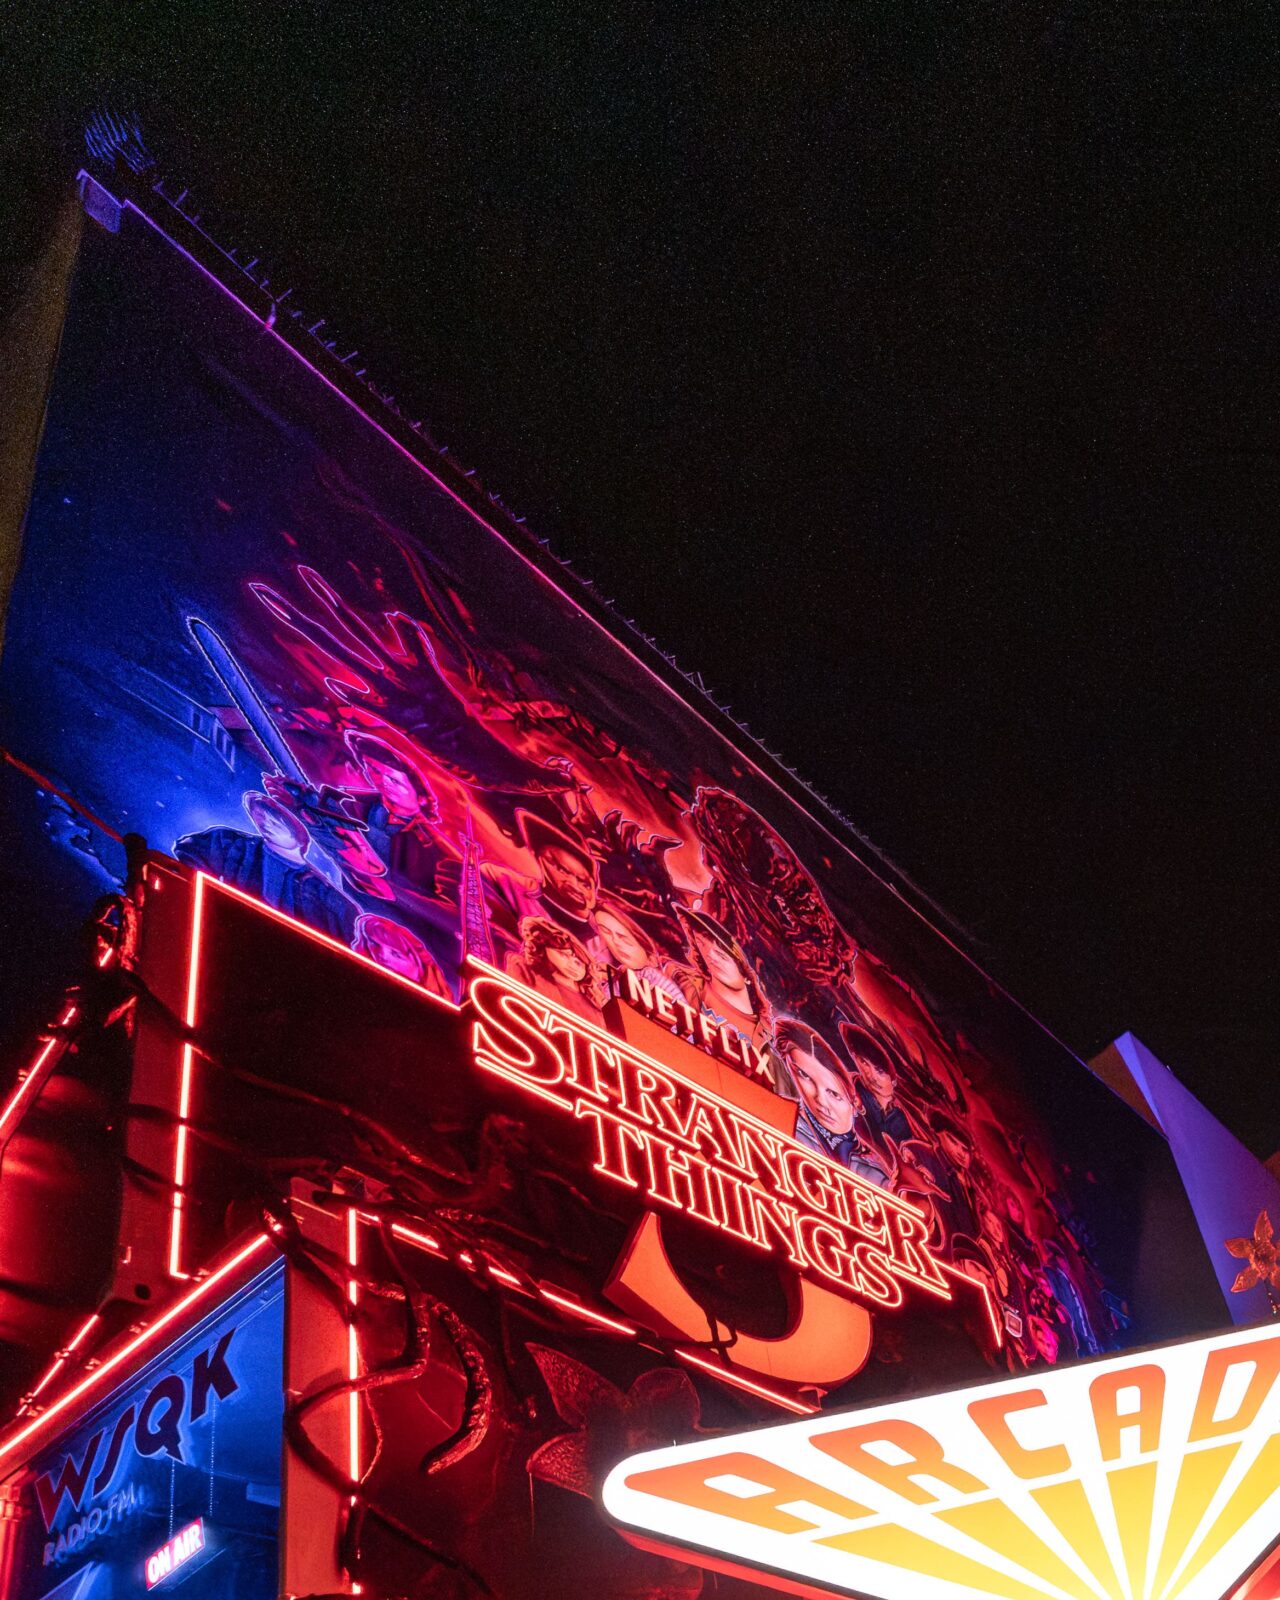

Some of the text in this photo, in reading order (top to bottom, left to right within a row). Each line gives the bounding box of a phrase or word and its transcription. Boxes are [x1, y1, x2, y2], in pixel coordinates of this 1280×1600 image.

[470, 976, 946, 1286] STRANGER
[626, 972, 776, 1085] NETFLIX
[574, 1098, 903, 1308] THINGS
[35, 1327, 239, 1534] WSQK
[148, 1523, 201, 1584] ON AIR
